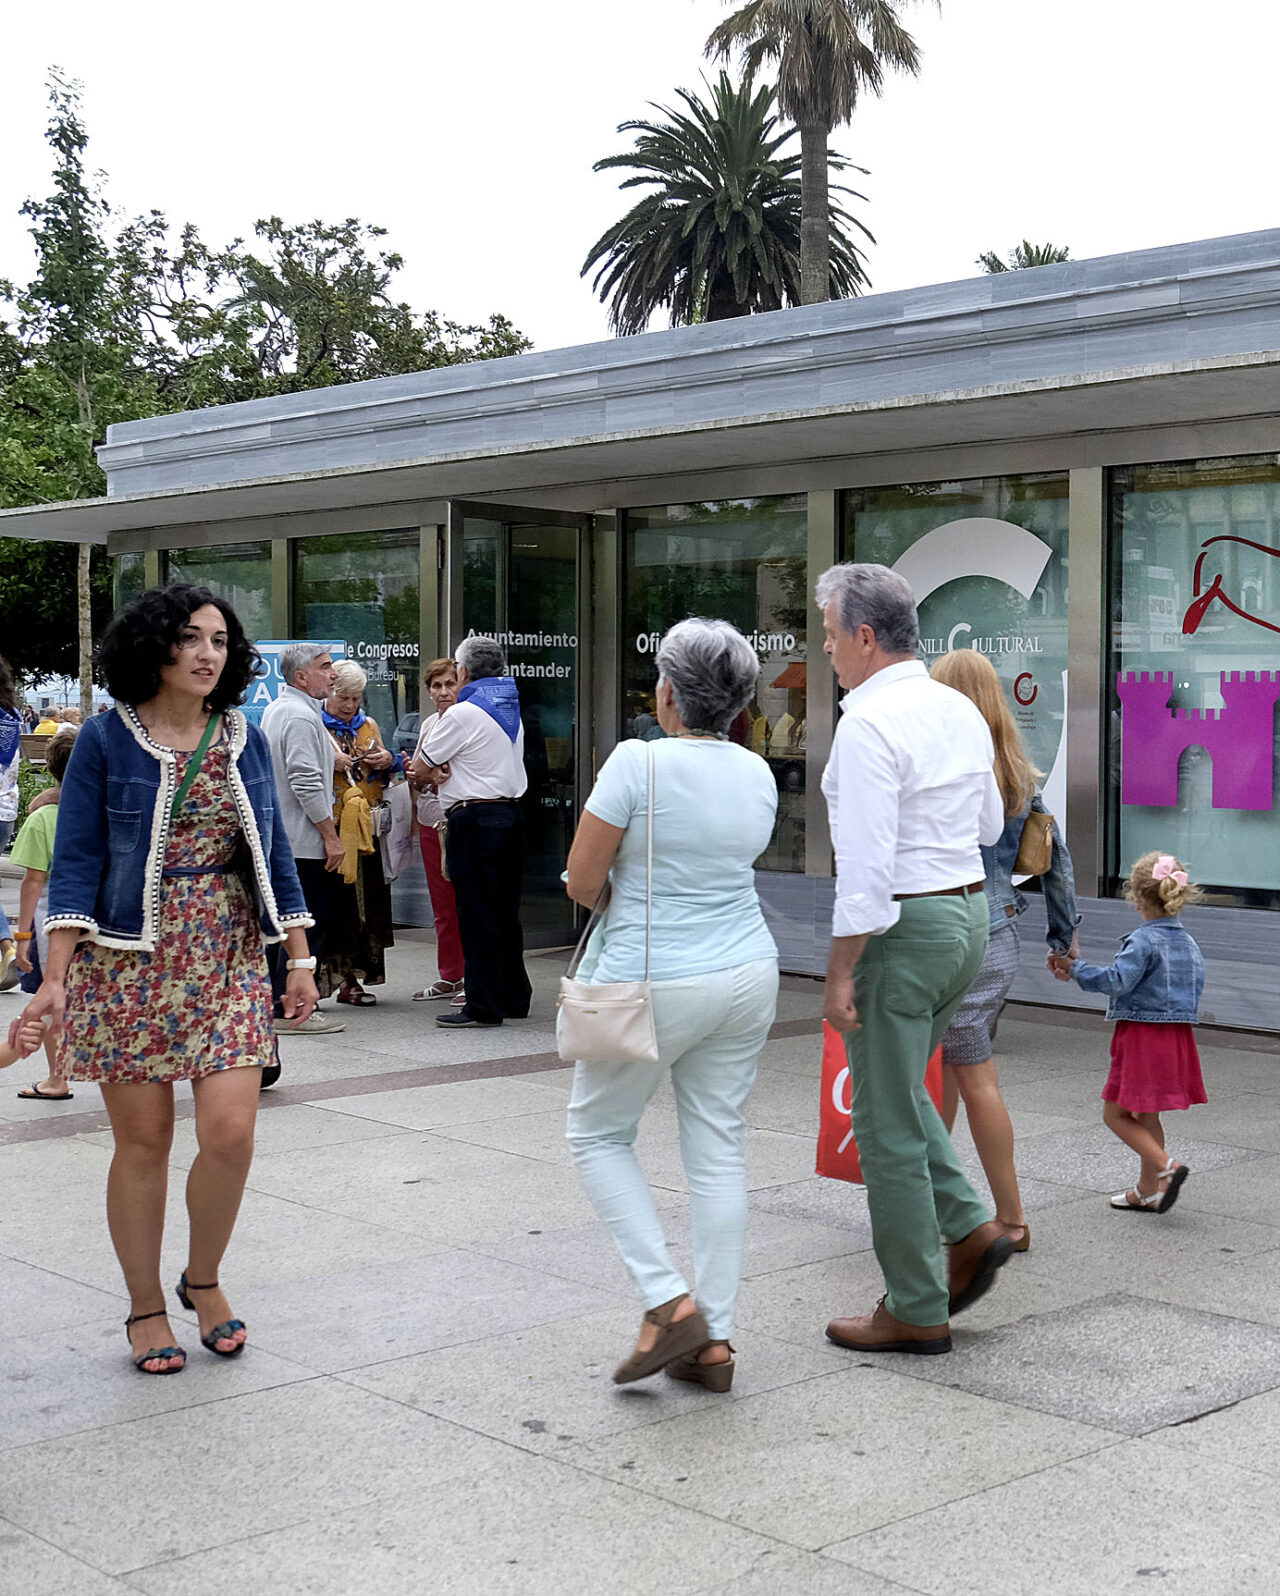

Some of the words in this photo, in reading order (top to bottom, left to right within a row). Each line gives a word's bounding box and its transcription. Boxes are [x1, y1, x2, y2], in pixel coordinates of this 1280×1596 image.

[357, 641, 420, 660] Congresos
[636, 632, 660, 653] Ofi
[918, 638, 948, 654] NILL
[367, 667, 400, 681] Bureau
[503, 662, 572, 678] antander
